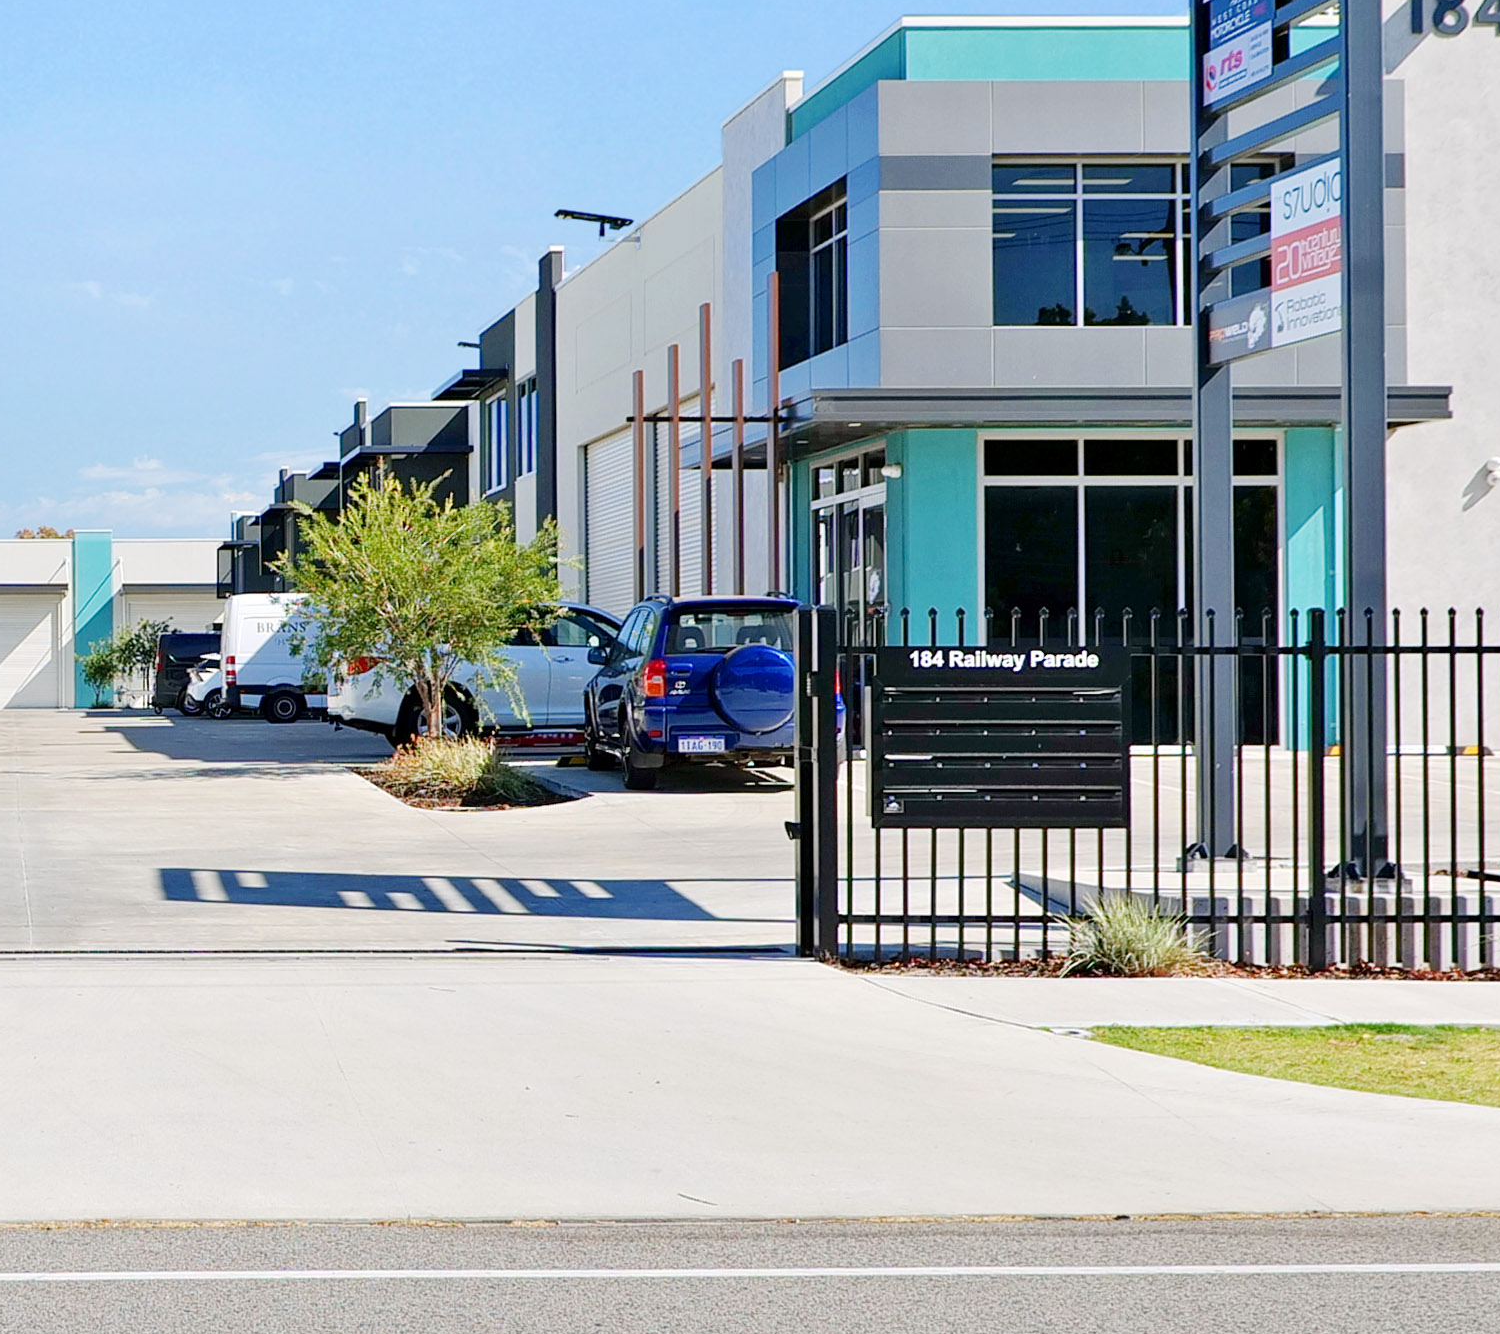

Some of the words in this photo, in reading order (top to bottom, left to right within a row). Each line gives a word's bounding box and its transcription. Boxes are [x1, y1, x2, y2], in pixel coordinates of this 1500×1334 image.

[1220, 49, 1243, 77] rts
[1287, 306, 1341, 331] Innovation
[909, 650, 945, 667] 184
[949, 650, 1026, 672] Railway
[1030, 650, 1099, 667] Parade
